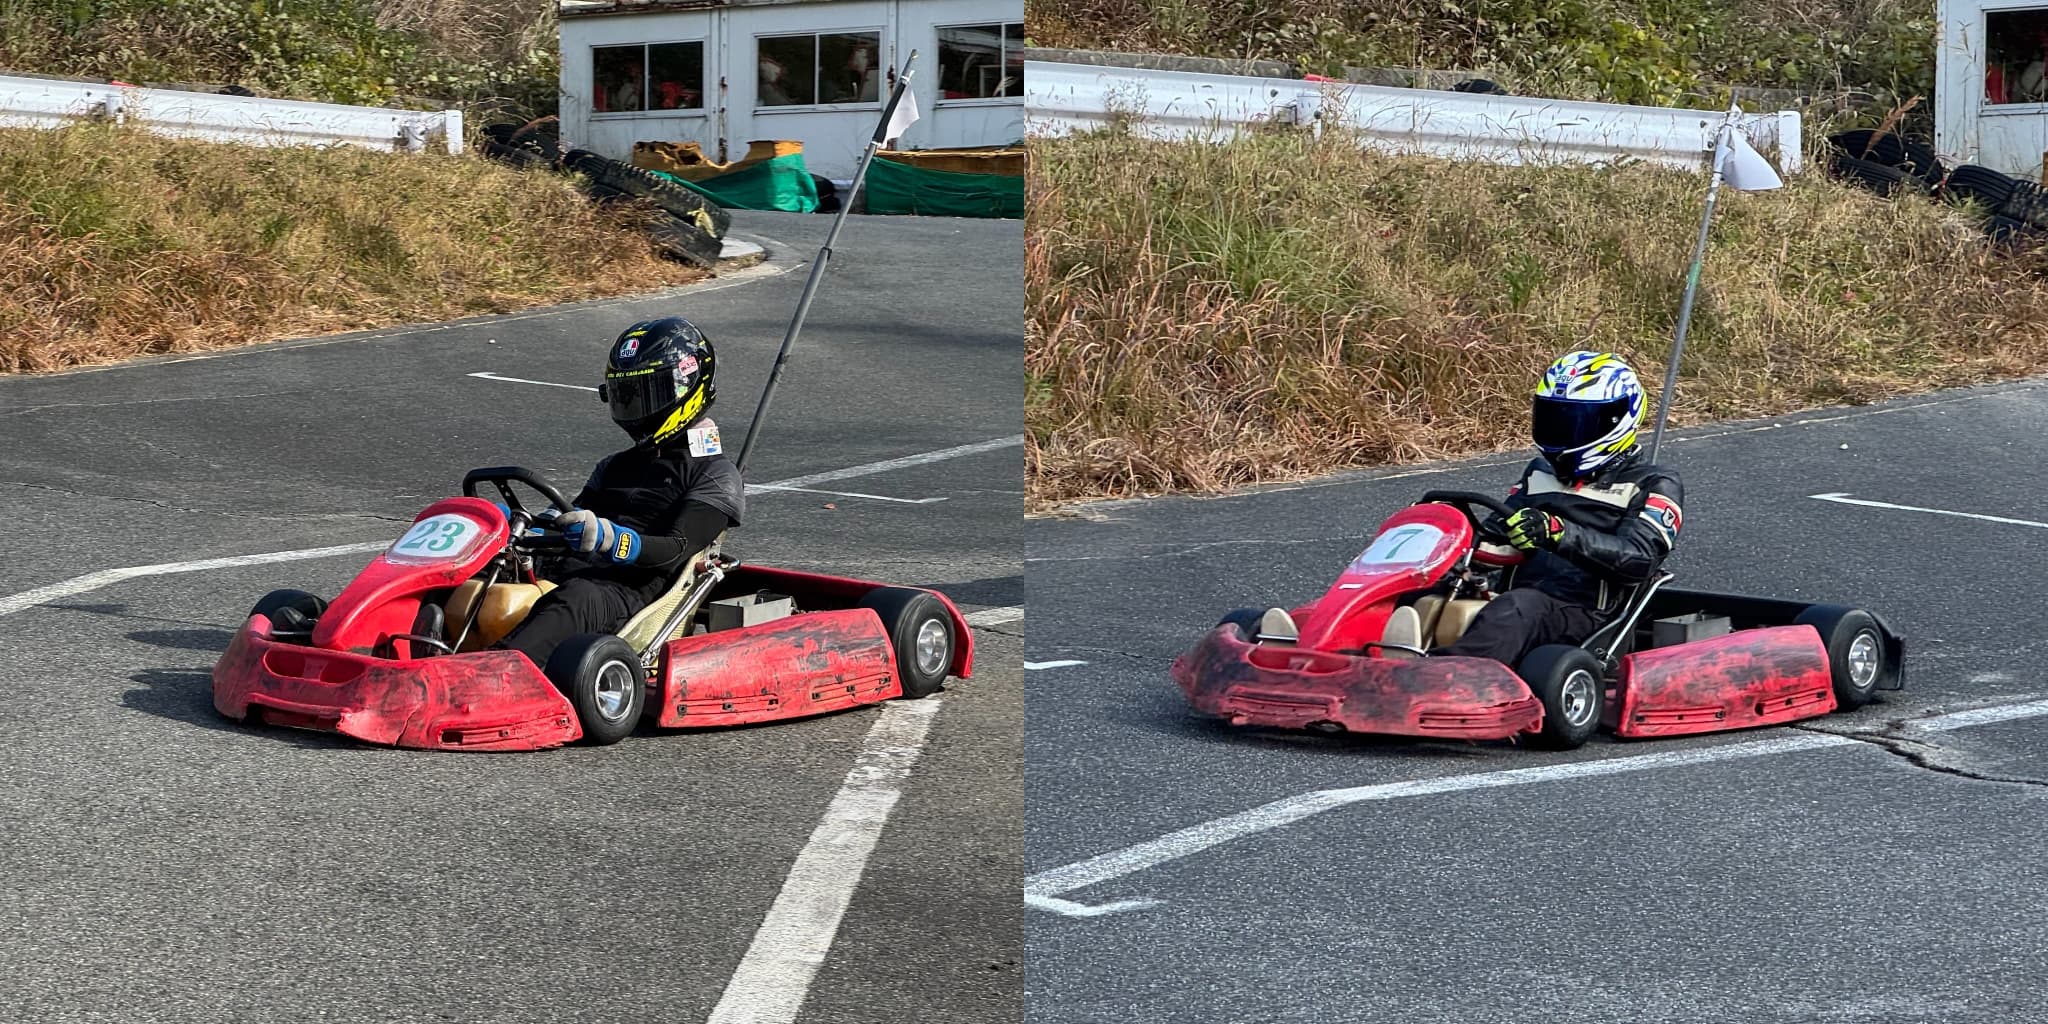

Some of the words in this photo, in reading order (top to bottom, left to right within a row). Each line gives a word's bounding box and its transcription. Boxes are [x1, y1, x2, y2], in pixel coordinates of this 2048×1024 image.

[653, 383, 704, 438] 46
[400, 520, 466, 551] 23
[618, 533, 631, 557] OMP
[1384, 529, 1425, 559] 7
